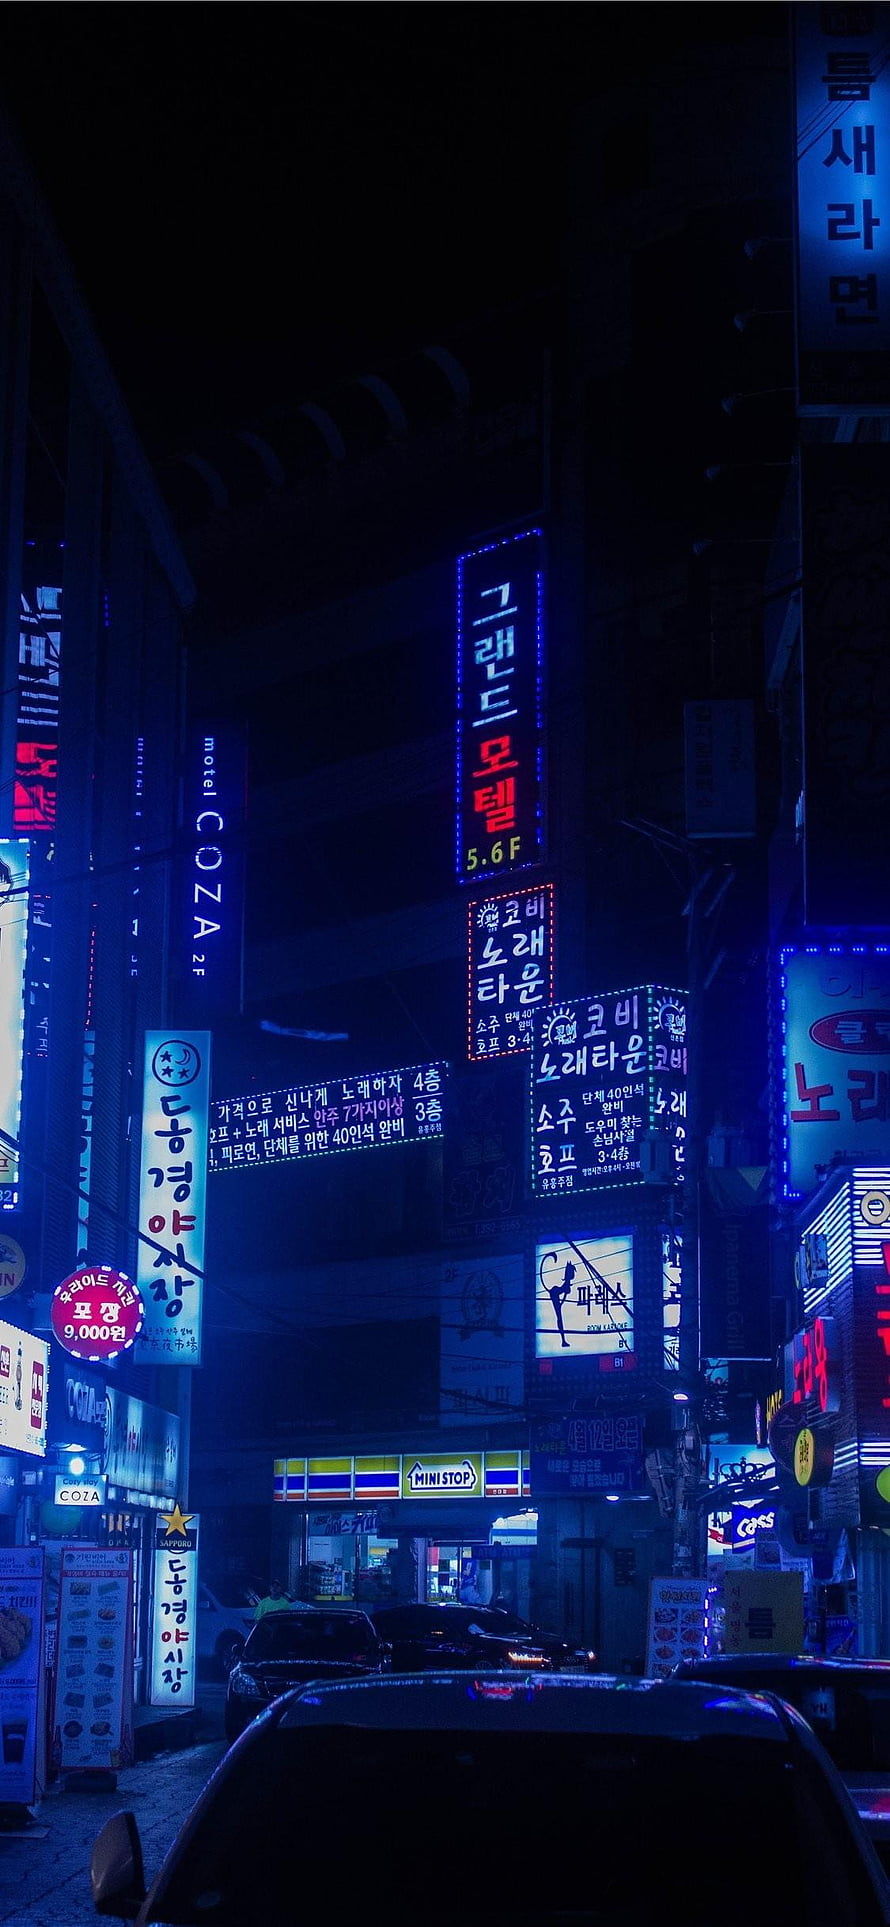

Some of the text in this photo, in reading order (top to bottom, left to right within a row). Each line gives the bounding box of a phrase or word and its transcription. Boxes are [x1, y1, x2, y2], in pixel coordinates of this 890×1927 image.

[822, 51, 880, 327] 틈새라면
[472, 582, 518, 834] 그랜드 모텔
[192, 737, 224, 978] motel COZA 2F
[502, 893, 545, 928] 코비
[477, 925, 544, 970] 노래
[477, 963, 544, 1005] 타운
[476, 1015, 500, 1034] 소주
[583, 995, 639, 1039] 코비
[475, 1037, 500, 1055] 호프
[536, 1034, 647, 1084] 노래타운
[654, 1044, 688, 1076] 코비
[413, 1068, 442, 1093] 4층
[582, 1083, 645, 1105] 단체 40인석
[218, 1074, 403, 1123] 가격으로 신나게 노래하자
[415, 1100, 443, 1122] 3층
[602, 1101, 624, 1116] 완비
[245, 1119, 269, 1139] 노래
[273, 1112, 310, 1136] 서비스
[313, 1107, 340, 1129] 안주
[342, 1096, 404, 1123] 7가지이상
[536, 1099, 576, 1135] 소주
[584, 1114, 642, 1134] 도우미 찾는
[264, 1134, 300, 1158] 단체를
[304, 1130, 329, 1152] 위한
[333, 1122, 375, 1145] 40인석
[379, 1118, 405, 1141] 완비
[592, 1129, 635, 1148] 손님사절
[537, 1144, 577, 1175] 호프
[542, 1176, 573, 1191] 유흥주점
[147, 1094, 197, 1318] 동경야시장
[112, 1280, 136, 1308] 치킨
[576, 1282, 628, 1316] 파레스
[64, 1325, 126, 1342] 9,000원
[614, 1357, 624, 1367] B1
[83, 1478, 99, 1486] stay
[415, 1471, 470, 1486] MINISTOP
[60, 1490, 100, 1503] COZA
[737, 1511, 776, 1538] Cass
[159, 1539, 192, 1548] SAPPORO
[161, 1558, 190, 1694] 동경야시장
